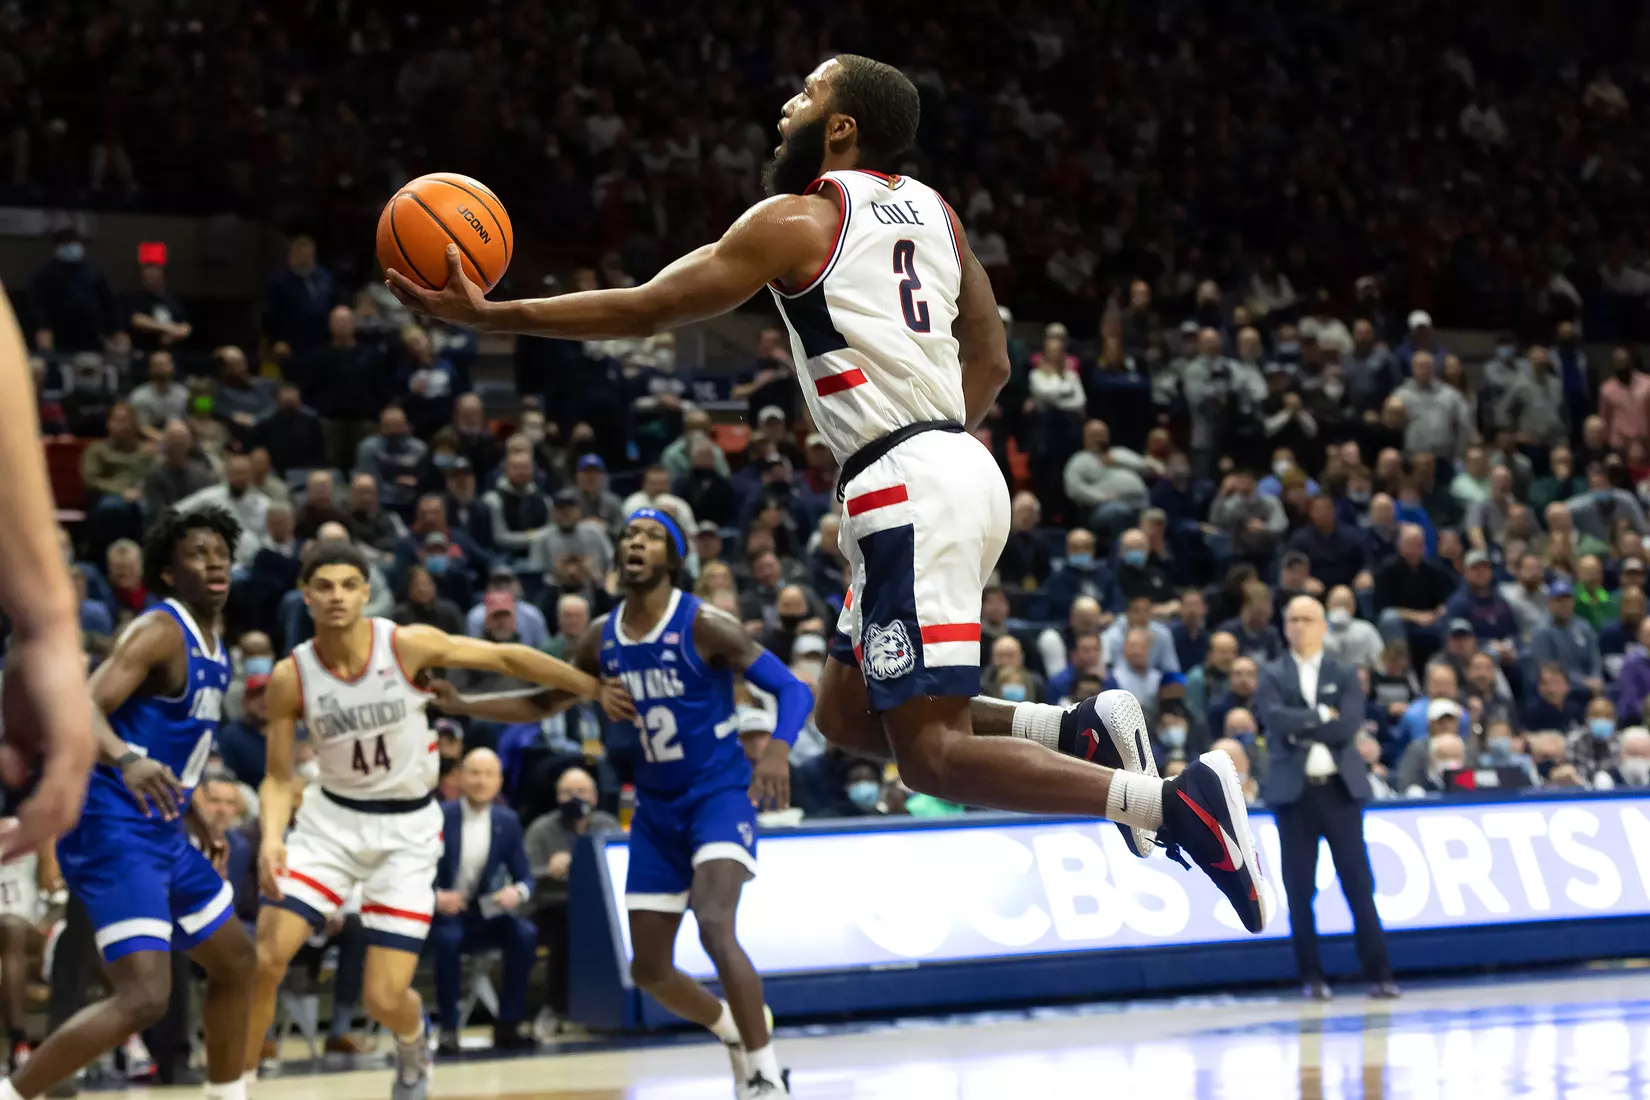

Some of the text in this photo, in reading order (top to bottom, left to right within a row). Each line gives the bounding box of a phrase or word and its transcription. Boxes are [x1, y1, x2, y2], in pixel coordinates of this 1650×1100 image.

[457, 203, 492, 245] UCONN
[870, 200, 925, 226] COLE
[892, 238, 931, 333] 2
[351, 733, 392, 776] 44
[955, 824, 1190, 946] CBS
